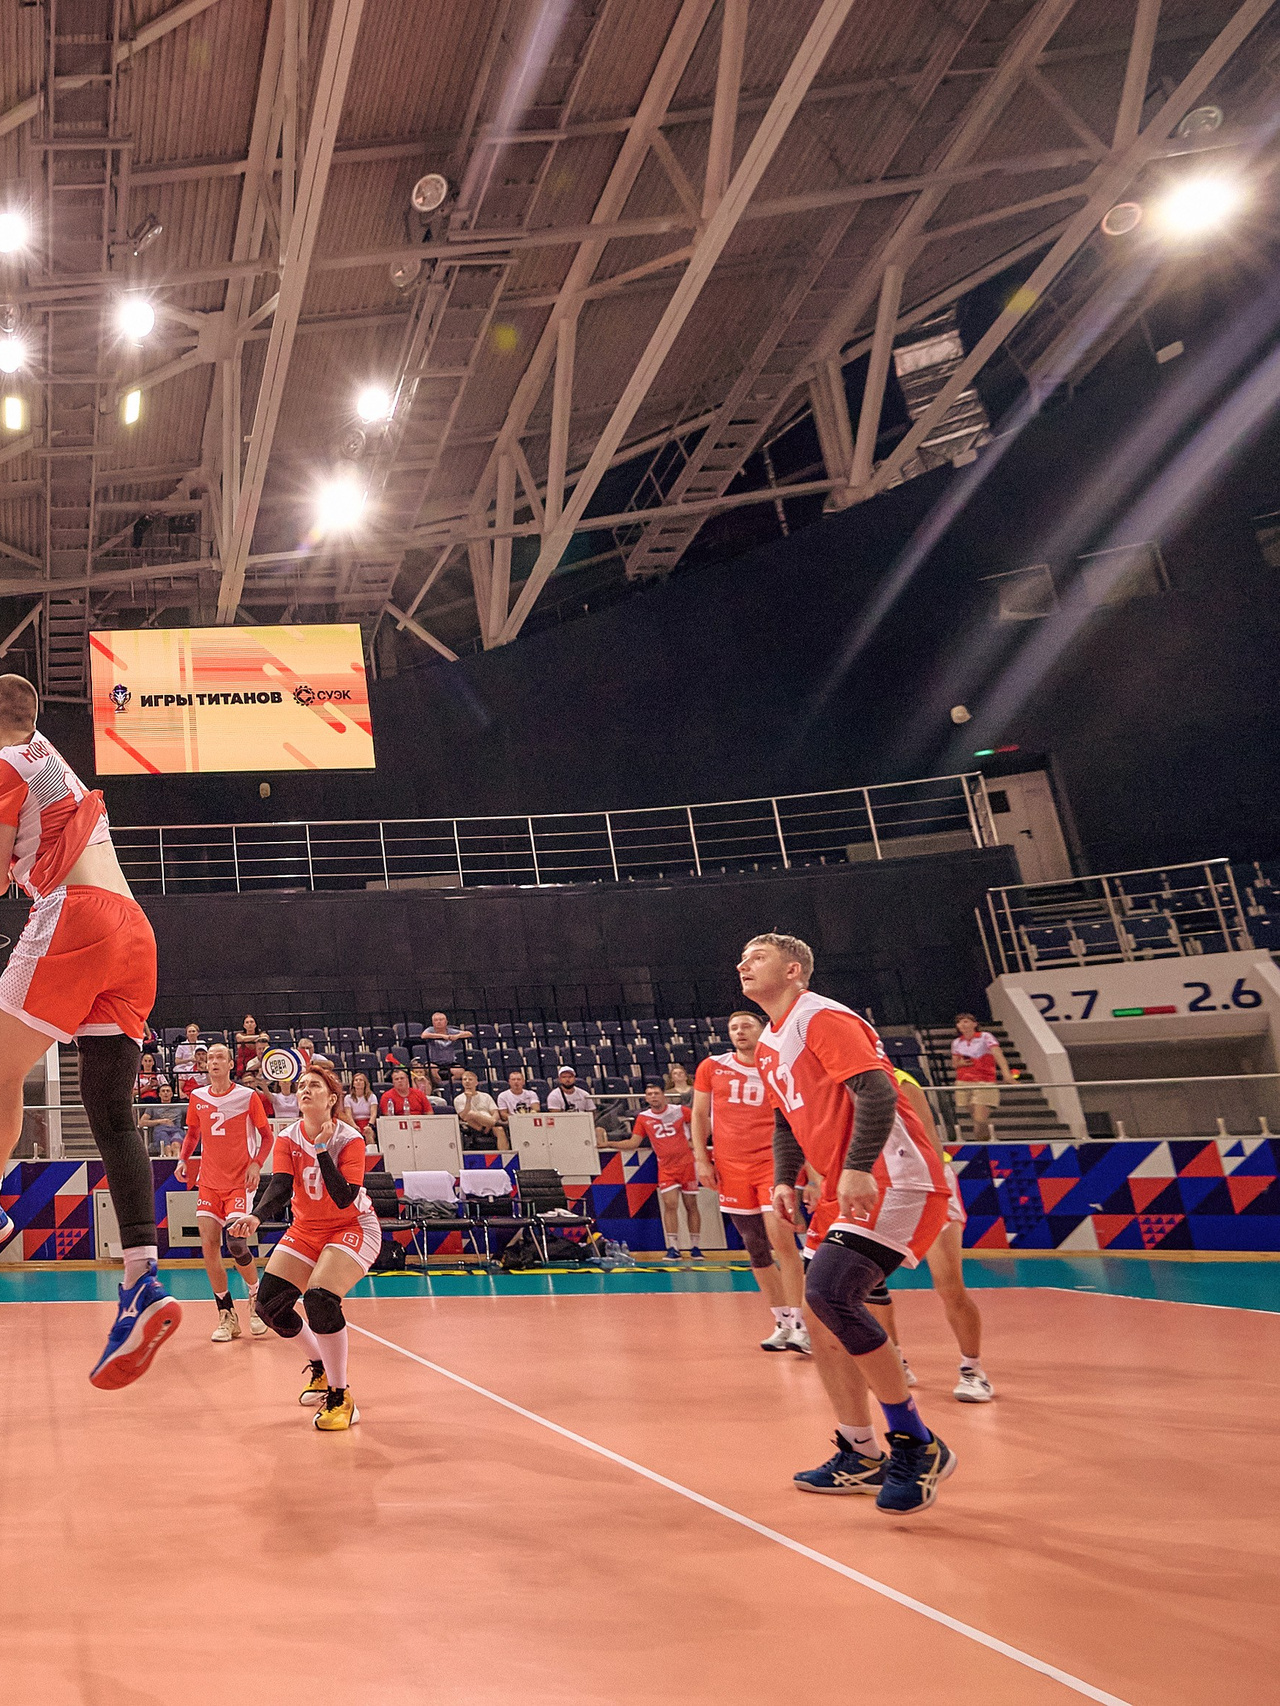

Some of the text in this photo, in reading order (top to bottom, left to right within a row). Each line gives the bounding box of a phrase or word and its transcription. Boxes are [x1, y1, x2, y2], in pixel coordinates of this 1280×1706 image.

[140, 691, 283, 707] ИГРЫ ТИТАНОВ
[317, 689, 352, 701] СУЭК
[1030, 989, 1098, 1022] 2.7
[1183, 978, 1263, 1012] 2.6
[727, 1078, 766, 1107] 10
[767, 1062, 805, 1113] 12
[209, 1111, 226, 1136] 2
[652, 1122, 677, 1139] 25
[302, 1165, 324, 1201] 8
[234, 1197, 245, 1210] 2
